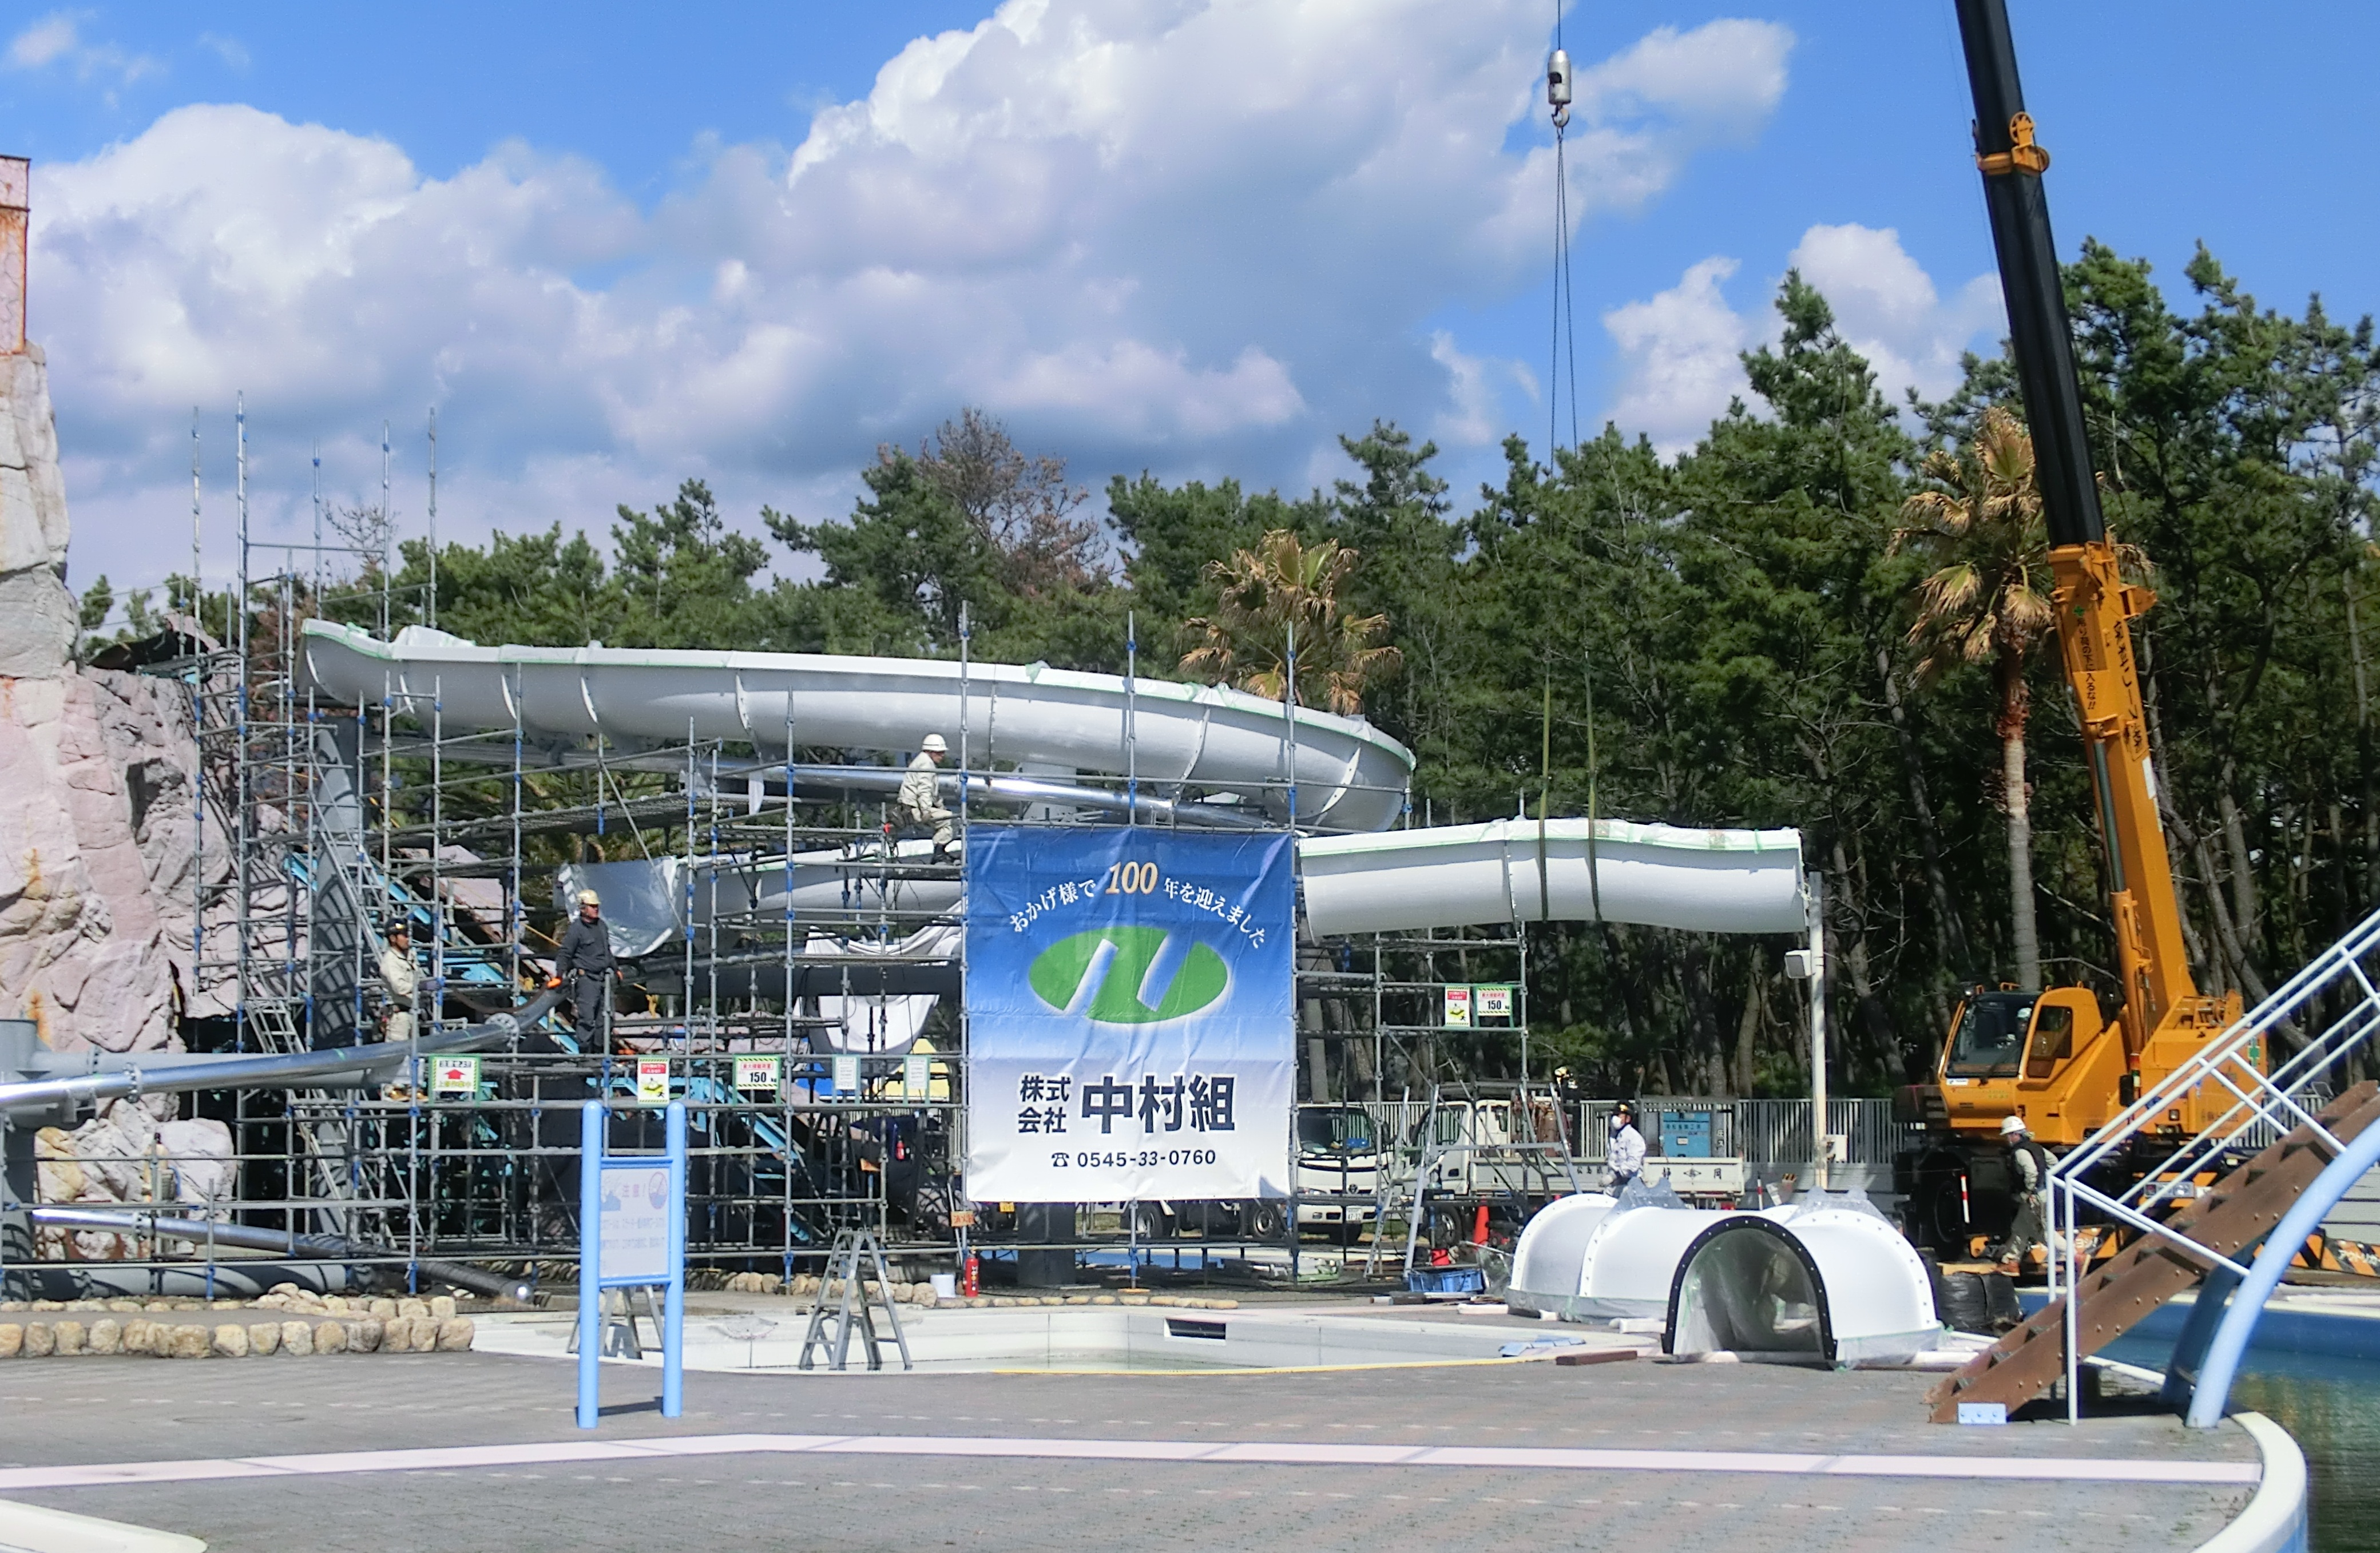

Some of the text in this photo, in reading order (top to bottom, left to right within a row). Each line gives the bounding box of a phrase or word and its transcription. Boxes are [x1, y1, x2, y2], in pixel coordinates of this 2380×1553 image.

[1010, 861, 1266, 949] おかげ様で 100 年を迎えました
[1488, 1000, 1501, 1010] 150
[750, 1071, 767, 1082] 150
[1020, 1075, 1072, 1102] 株式
[1081, 1076, 1236, 1134] 中村組
[1018, 1107, 1067, 1134] 会社
[1077, 1149, 1217, 1167] 0545-33-0760
